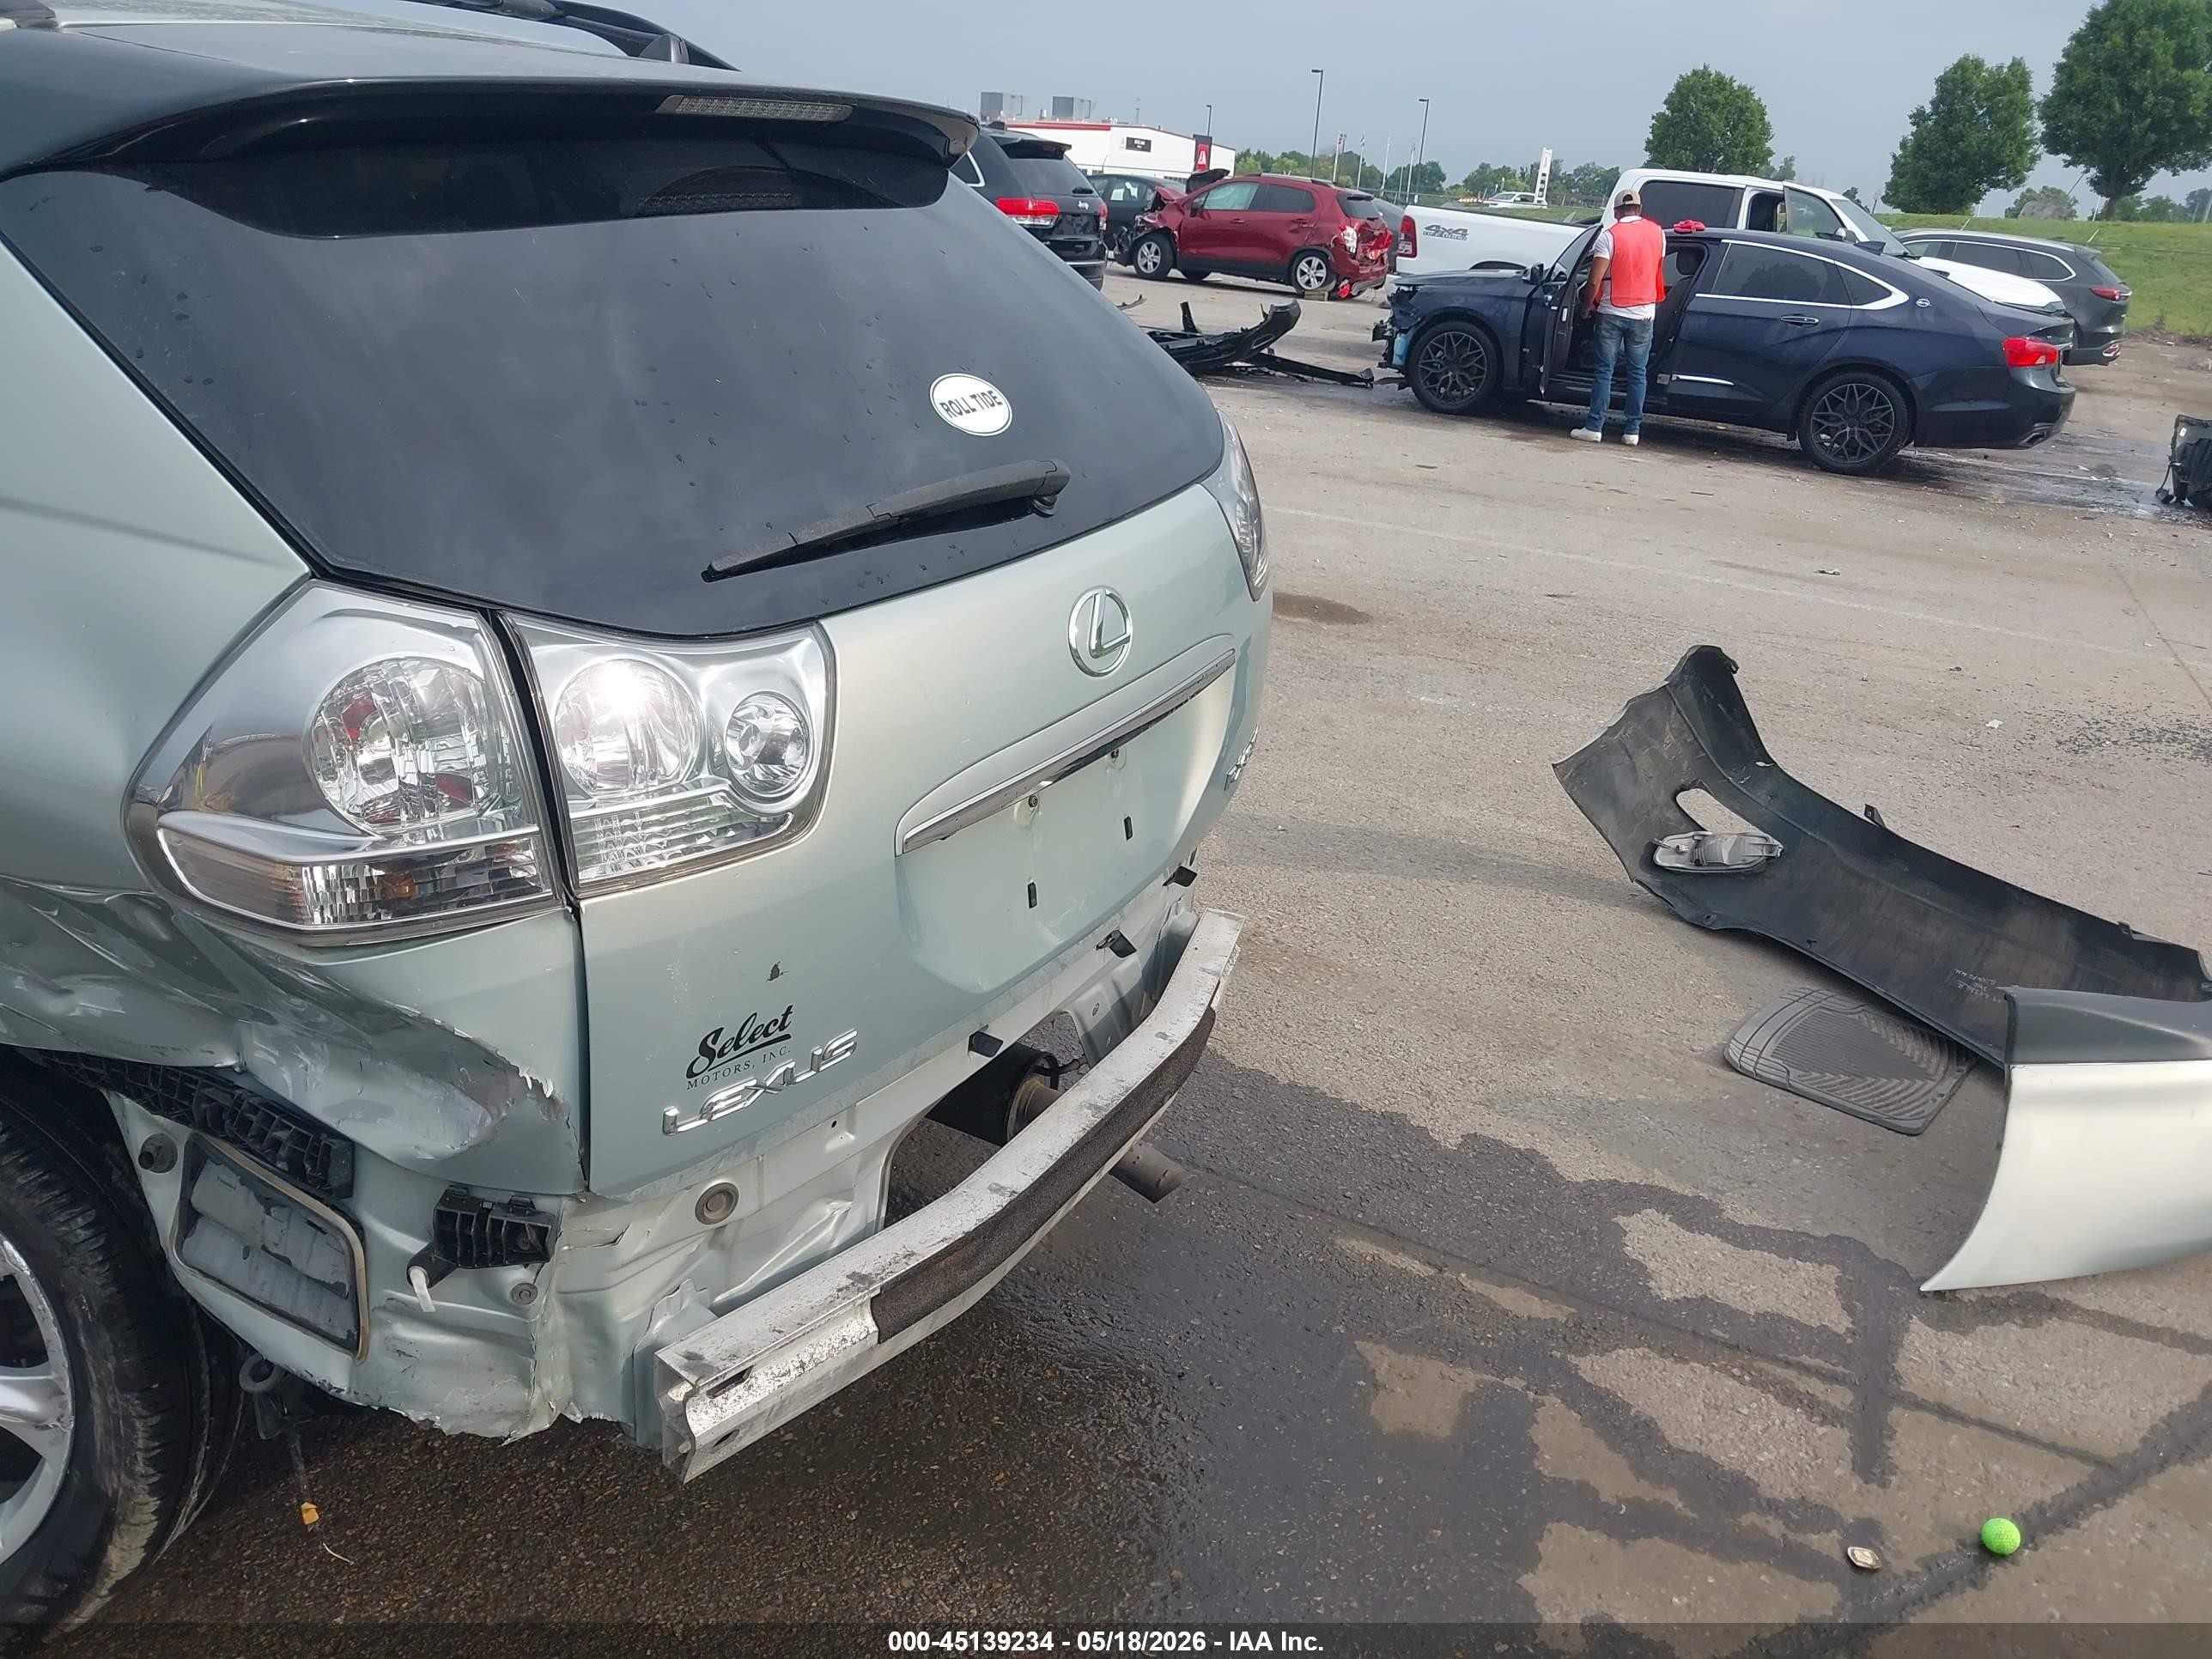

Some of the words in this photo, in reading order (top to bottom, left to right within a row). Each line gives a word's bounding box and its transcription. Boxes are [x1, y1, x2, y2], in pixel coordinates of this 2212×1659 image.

[939, 397, 977, 418] ROLL
[969, 390, 1003, 410] TIDE
[686, 1005, 793, 1079] Select
[686, 1060, 755, 1090] MOTORS,
[763, 1046, 791, 1063] INC.
[662, 1029, 859, 1136] LEXUS
